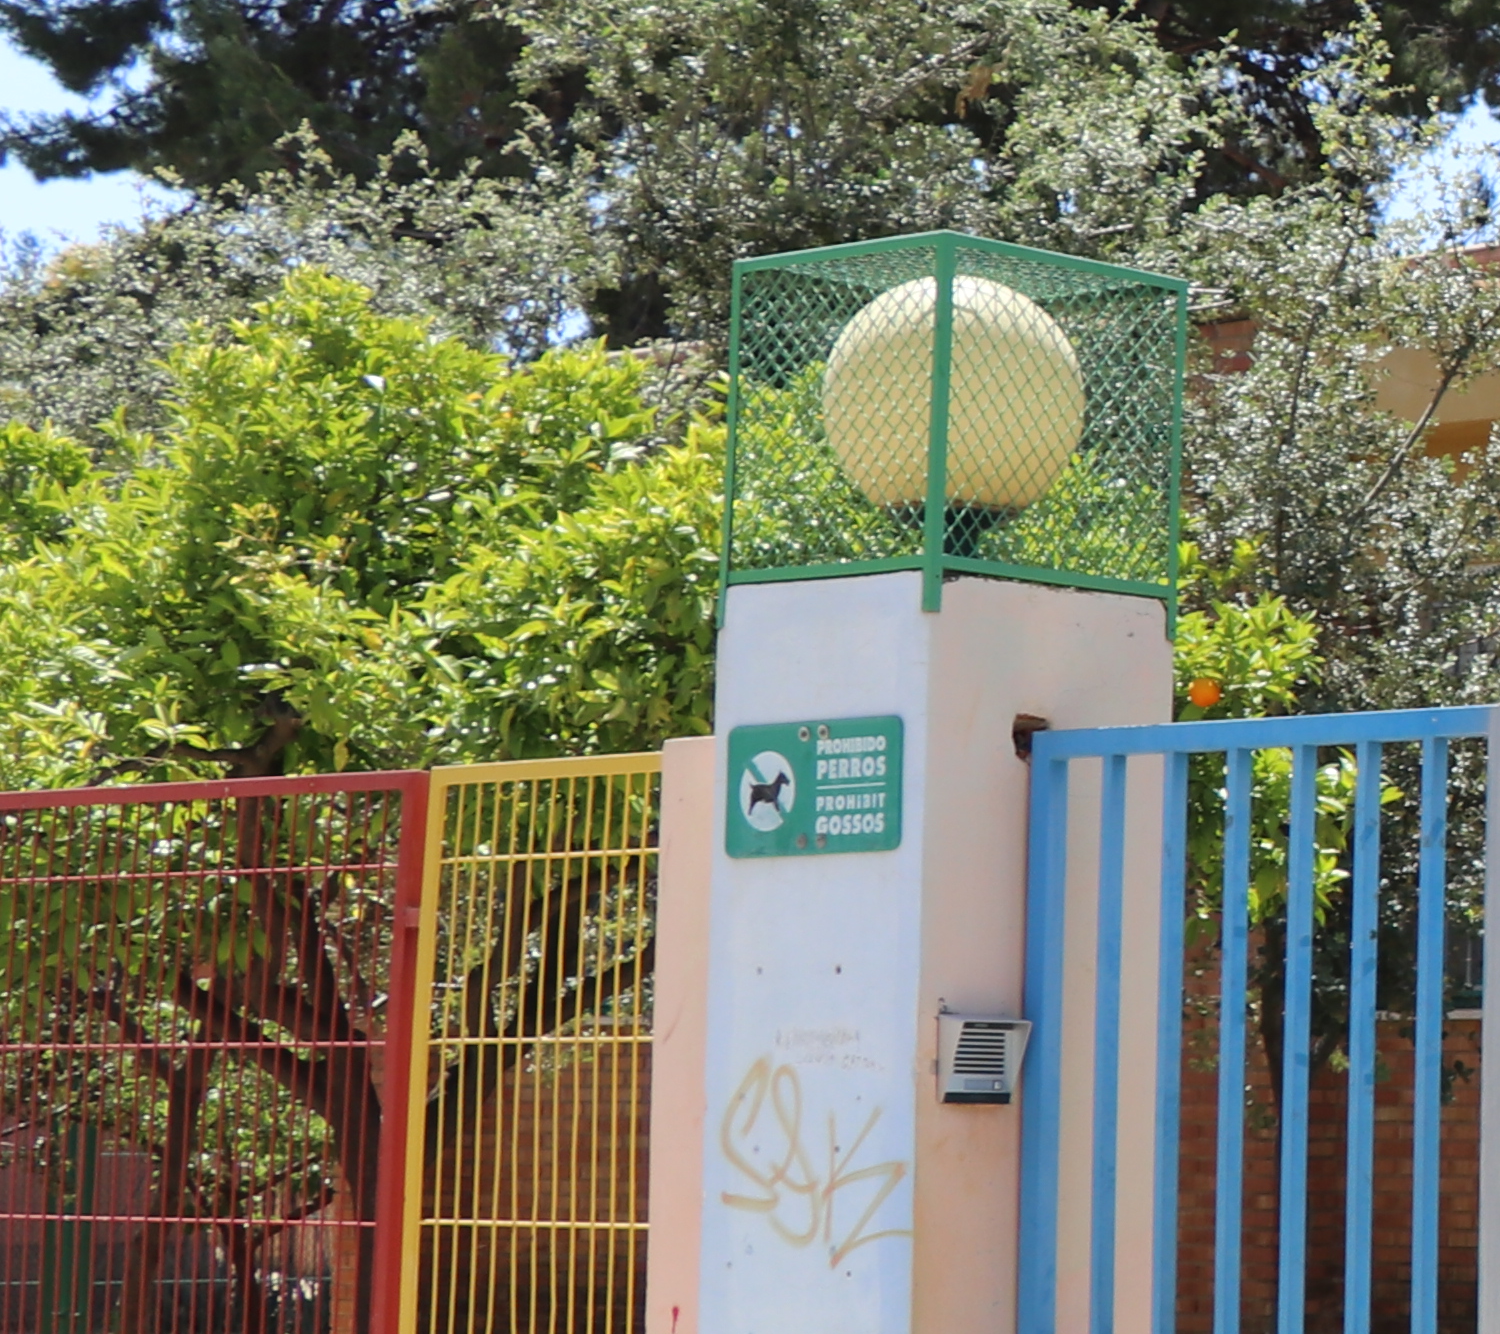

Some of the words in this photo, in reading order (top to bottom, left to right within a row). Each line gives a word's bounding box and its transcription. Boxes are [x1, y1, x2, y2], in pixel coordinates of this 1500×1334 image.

[816, 735, 887, 756] PROHIBIDO
[816, 755, 887, 780] PERROS
[815, 812, 885, 836] GOSSOS
